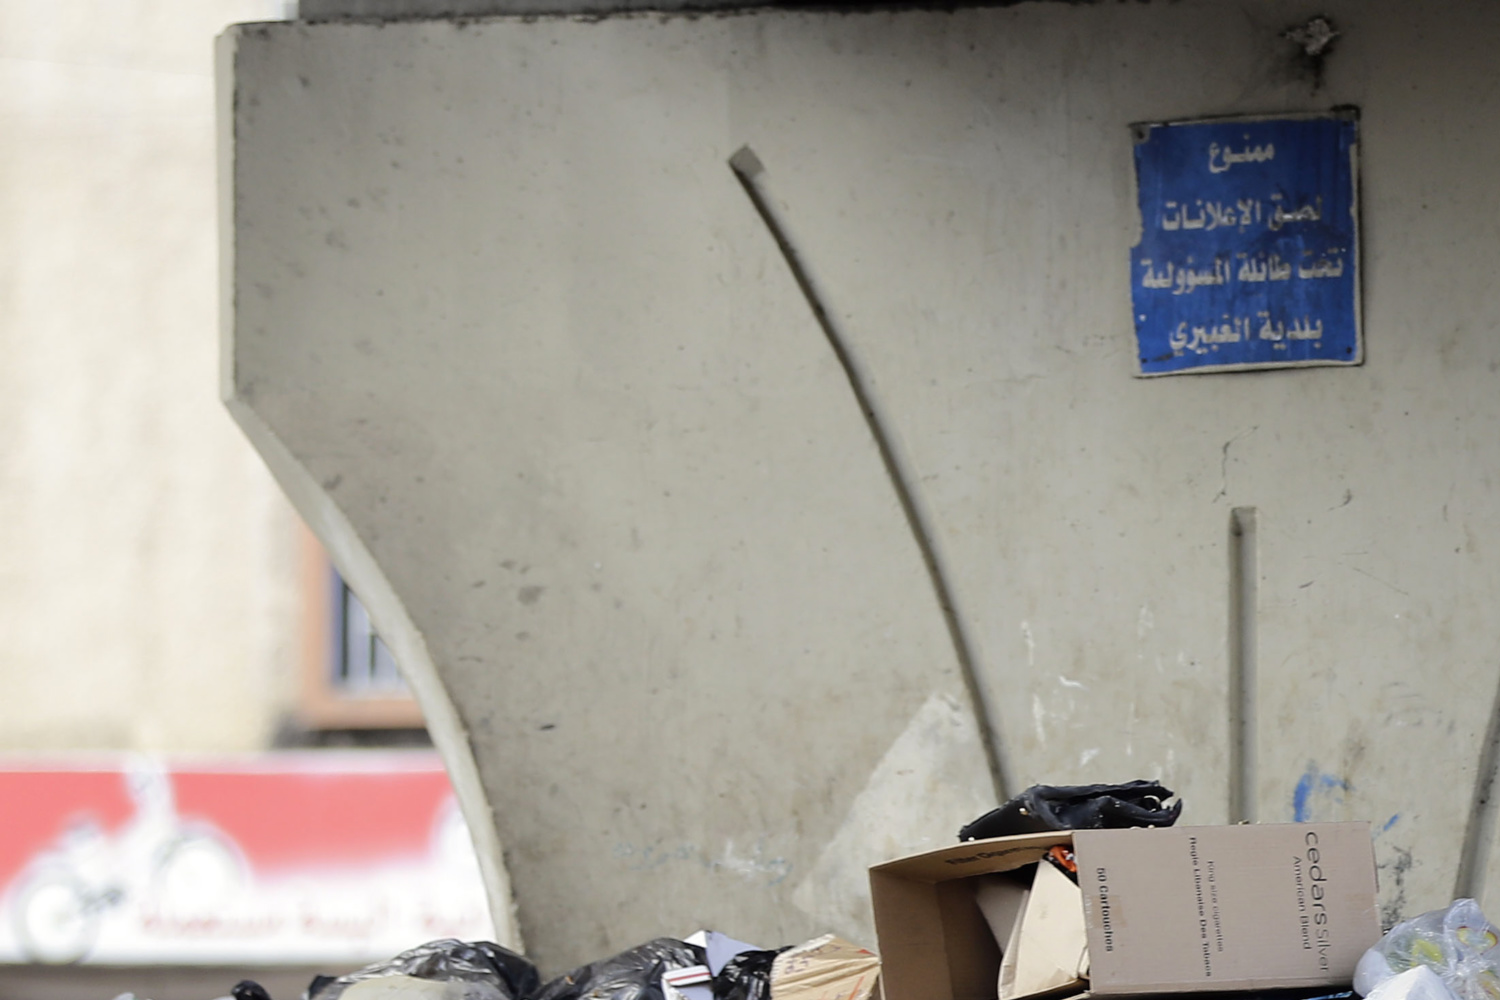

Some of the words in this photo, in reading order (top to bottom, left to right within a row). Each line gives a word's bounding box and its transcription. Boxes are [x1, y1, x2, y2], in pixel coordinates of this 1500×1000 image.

[1208, 134, 1275, 173] ممنوع
[1162, 198, 1261, 233] الإعلانات
[1267, 194, 1322, 231] لصق
[1237, 252, 1292, 282] طائلة
[1298, 247, 1343, 280] تحت
[1169, 314, 1250, 356] الغبيري
[1259, 311, 1323, 349] بلدية
[1096, 867, 1107, 882] 50
[1206, 860, 1215, 883] King
[1305, 831, 1327, 925] cedars
[1210, 885, 1218, 904] size
[1293, 856, 1306, 912] American
[1300, 915, 1313, 950] Blend
[1099, 885, 1114, 952] Cartouches
[1199, 919, 1207, 939] Des
